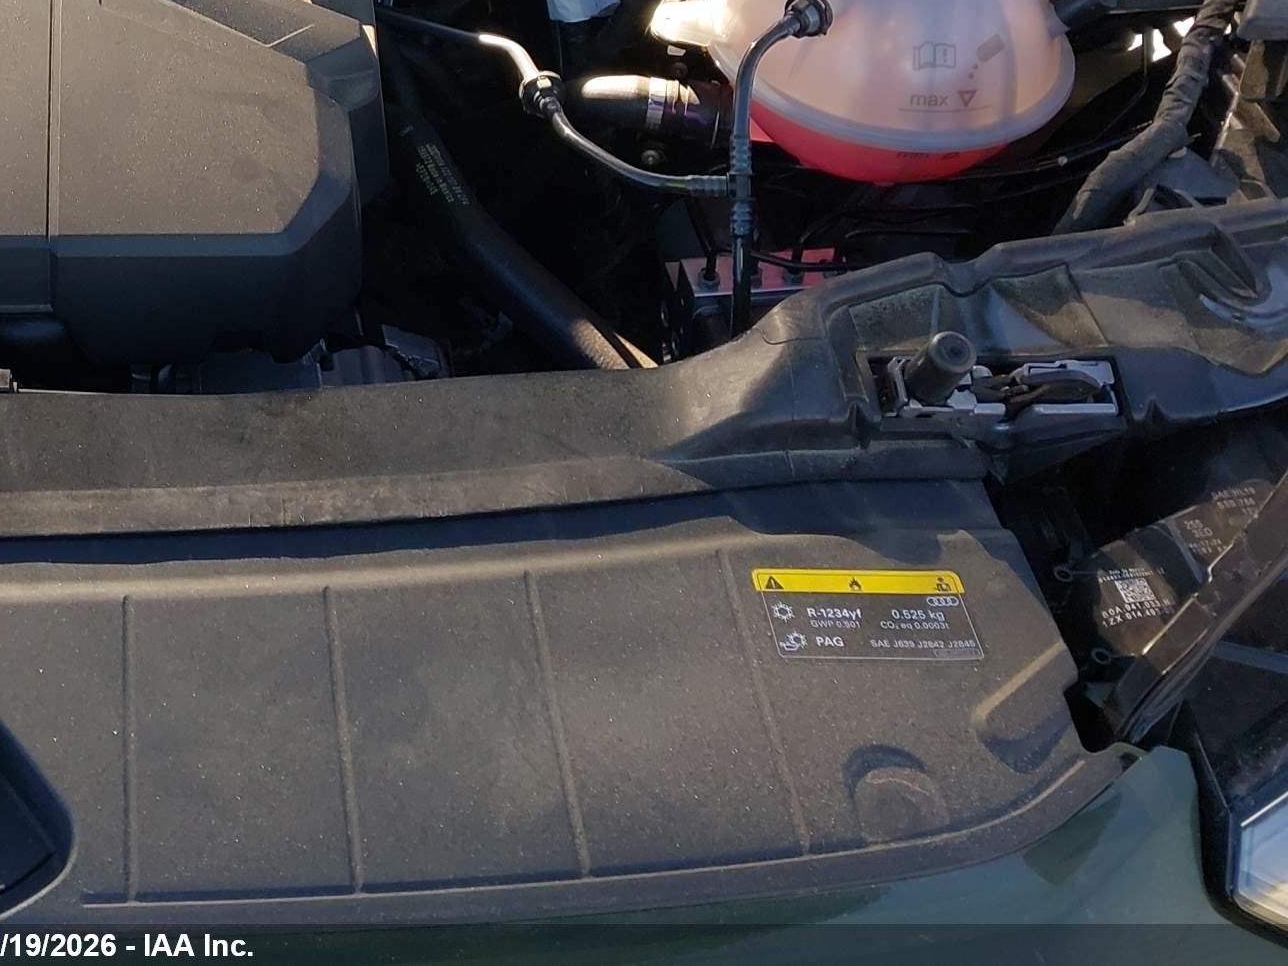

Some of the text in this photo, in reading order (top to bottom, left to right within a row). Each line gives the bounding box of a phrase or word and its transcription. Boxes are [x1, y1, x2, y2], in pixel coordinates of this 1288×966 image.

[909, 94, 949, 107] max
[806, 607, 863, 620] R-1234yf
[891, 609, 945, 622] 0.525 kg
[810, 619, 834, 628] GWP
[815, 636, 845, 647] PAG
[870, 639, 891, 648] SAE
